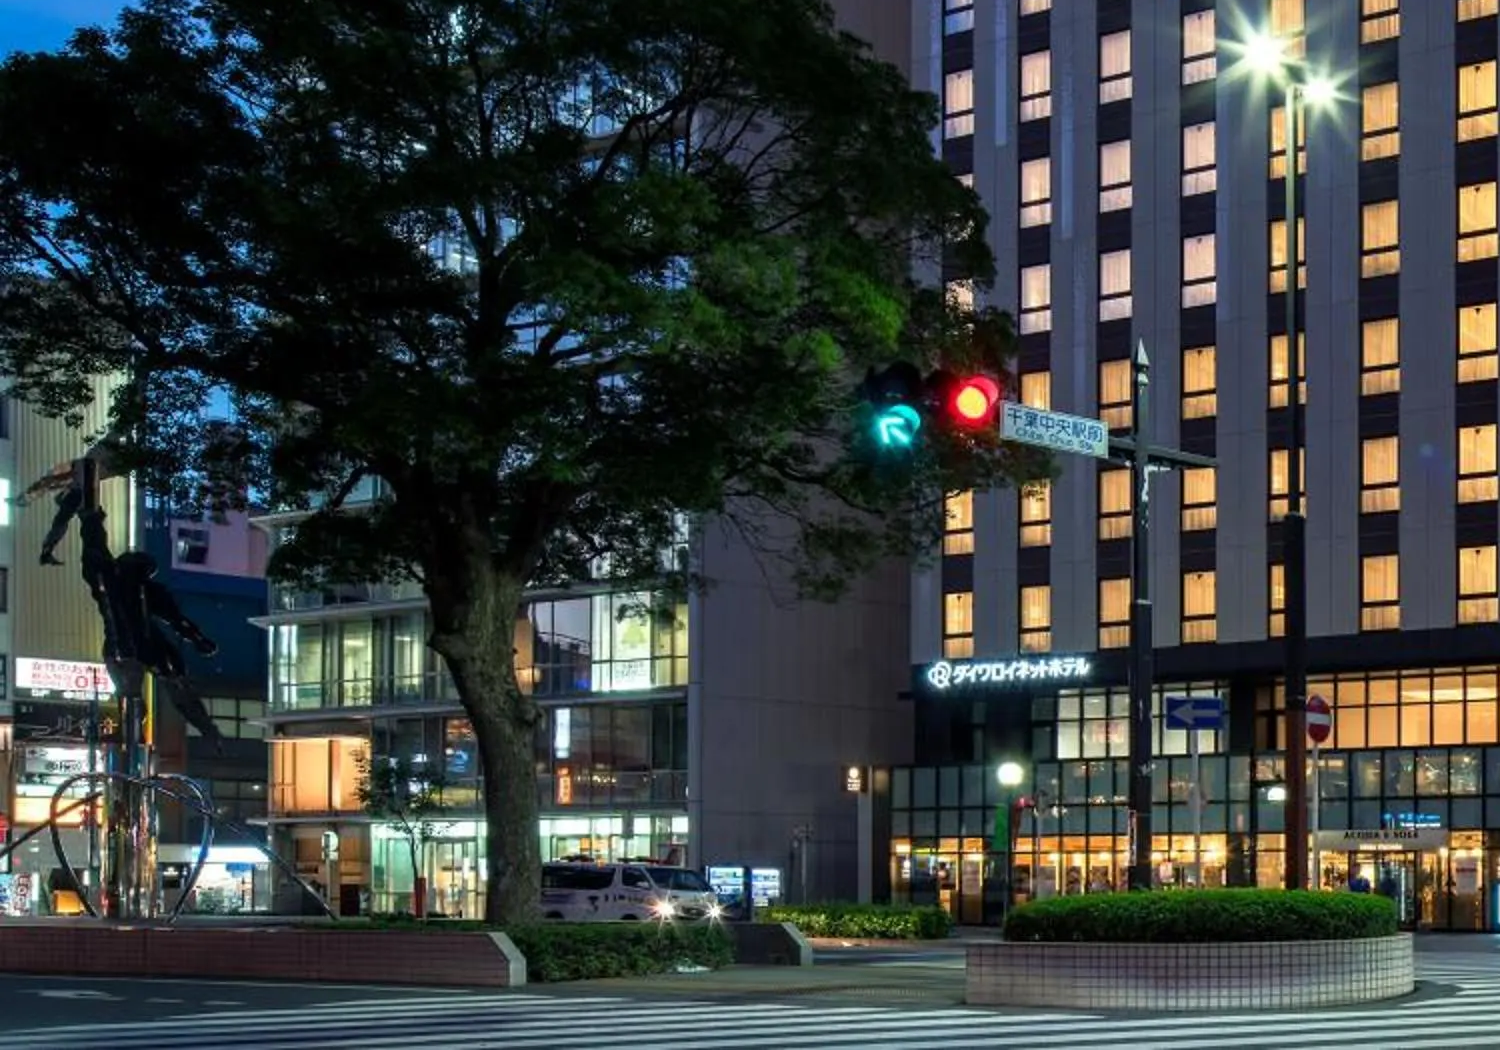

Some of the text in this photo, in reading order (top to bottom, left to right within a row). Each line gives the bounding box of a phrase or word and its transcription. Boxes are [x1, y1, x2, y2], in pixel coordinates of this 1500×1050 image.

[953, 657, 1090, 684] ダイワロイネットホテル
